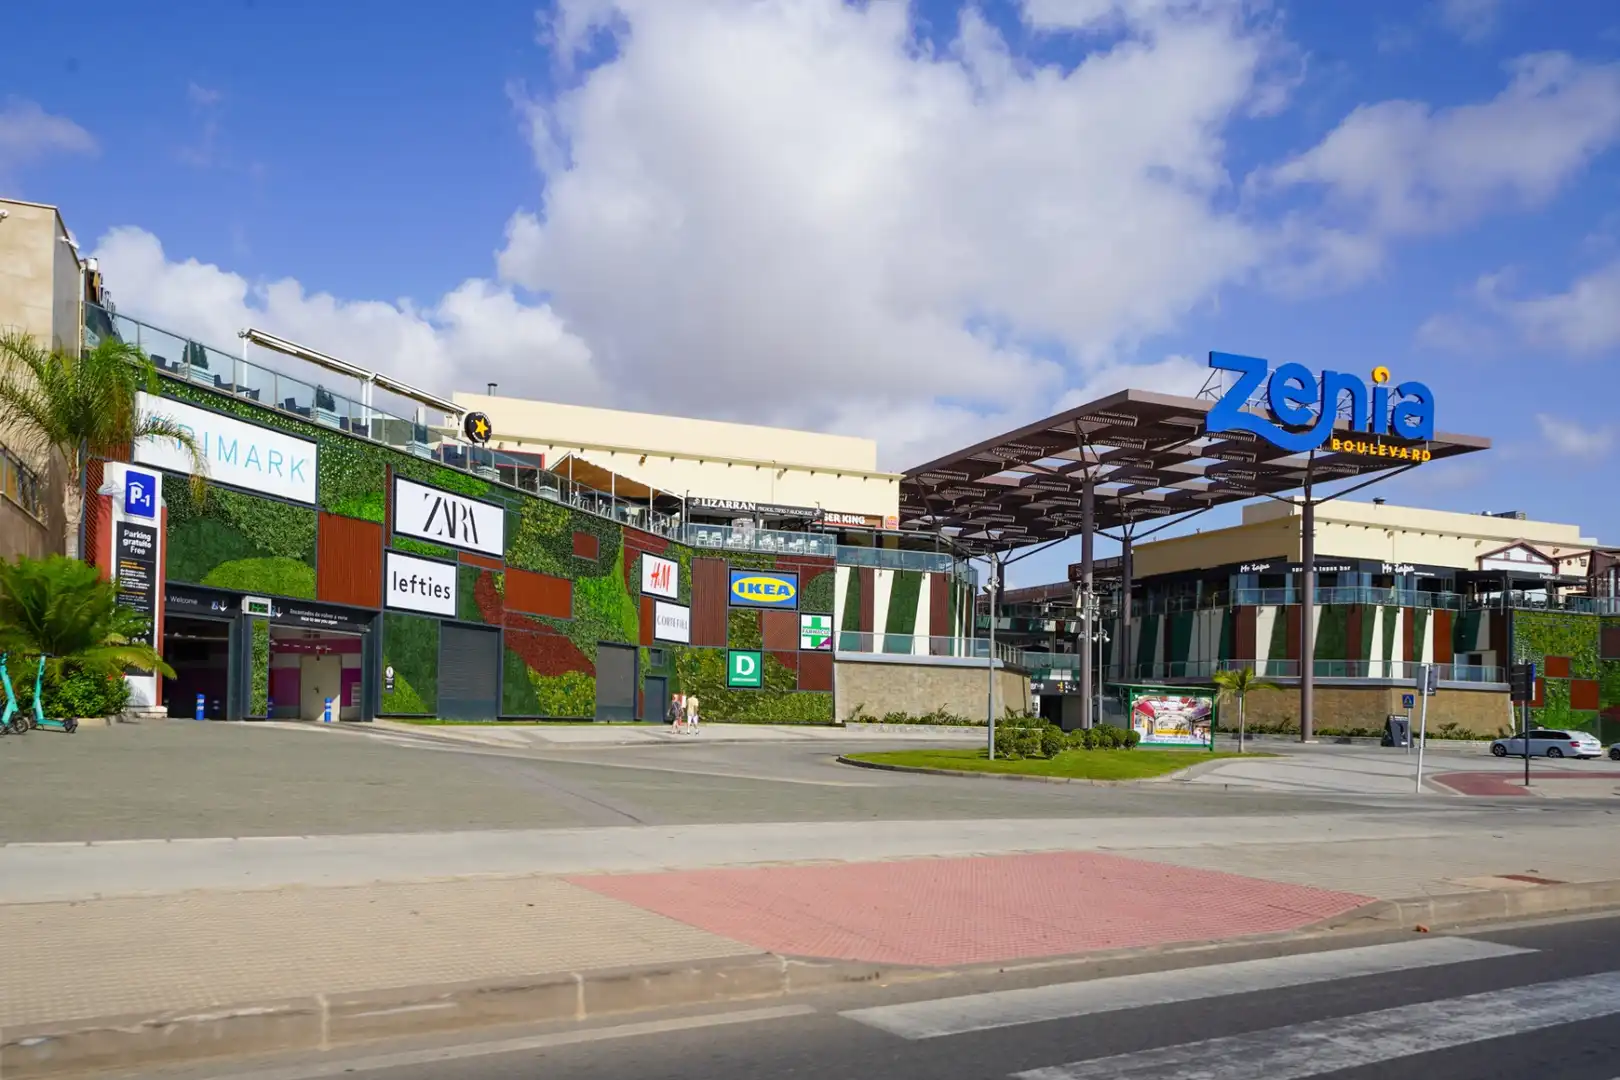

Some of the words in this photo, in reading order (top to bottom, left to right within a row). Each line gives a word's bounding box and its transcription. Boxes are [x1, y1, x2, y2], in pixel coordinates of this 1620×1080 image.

[1204, 351, 1434, 453] Zenia
[1331, 438, 1431, 462] BOULEVARD
[701, 499, 756, 511] LIZARRAN
[423, 493, 478, 544] ZARA
[842, 514, 865, 524] KING
[124, 529, 151, 541] Parking
[123, 539, 152, 548] gratuito
[130, 546, 146, 555] Free
[1240, 564, 1250, 572] Mr
[1381, 563, 1392, 574] Mr
[650, 562, 671, 592] H&M
[393, 571, 451, 599] lefties
[738, 582, 791, 596] IKEA
[170, 596, 198, 605] Welcome
[736, 655, 755, 676] D
